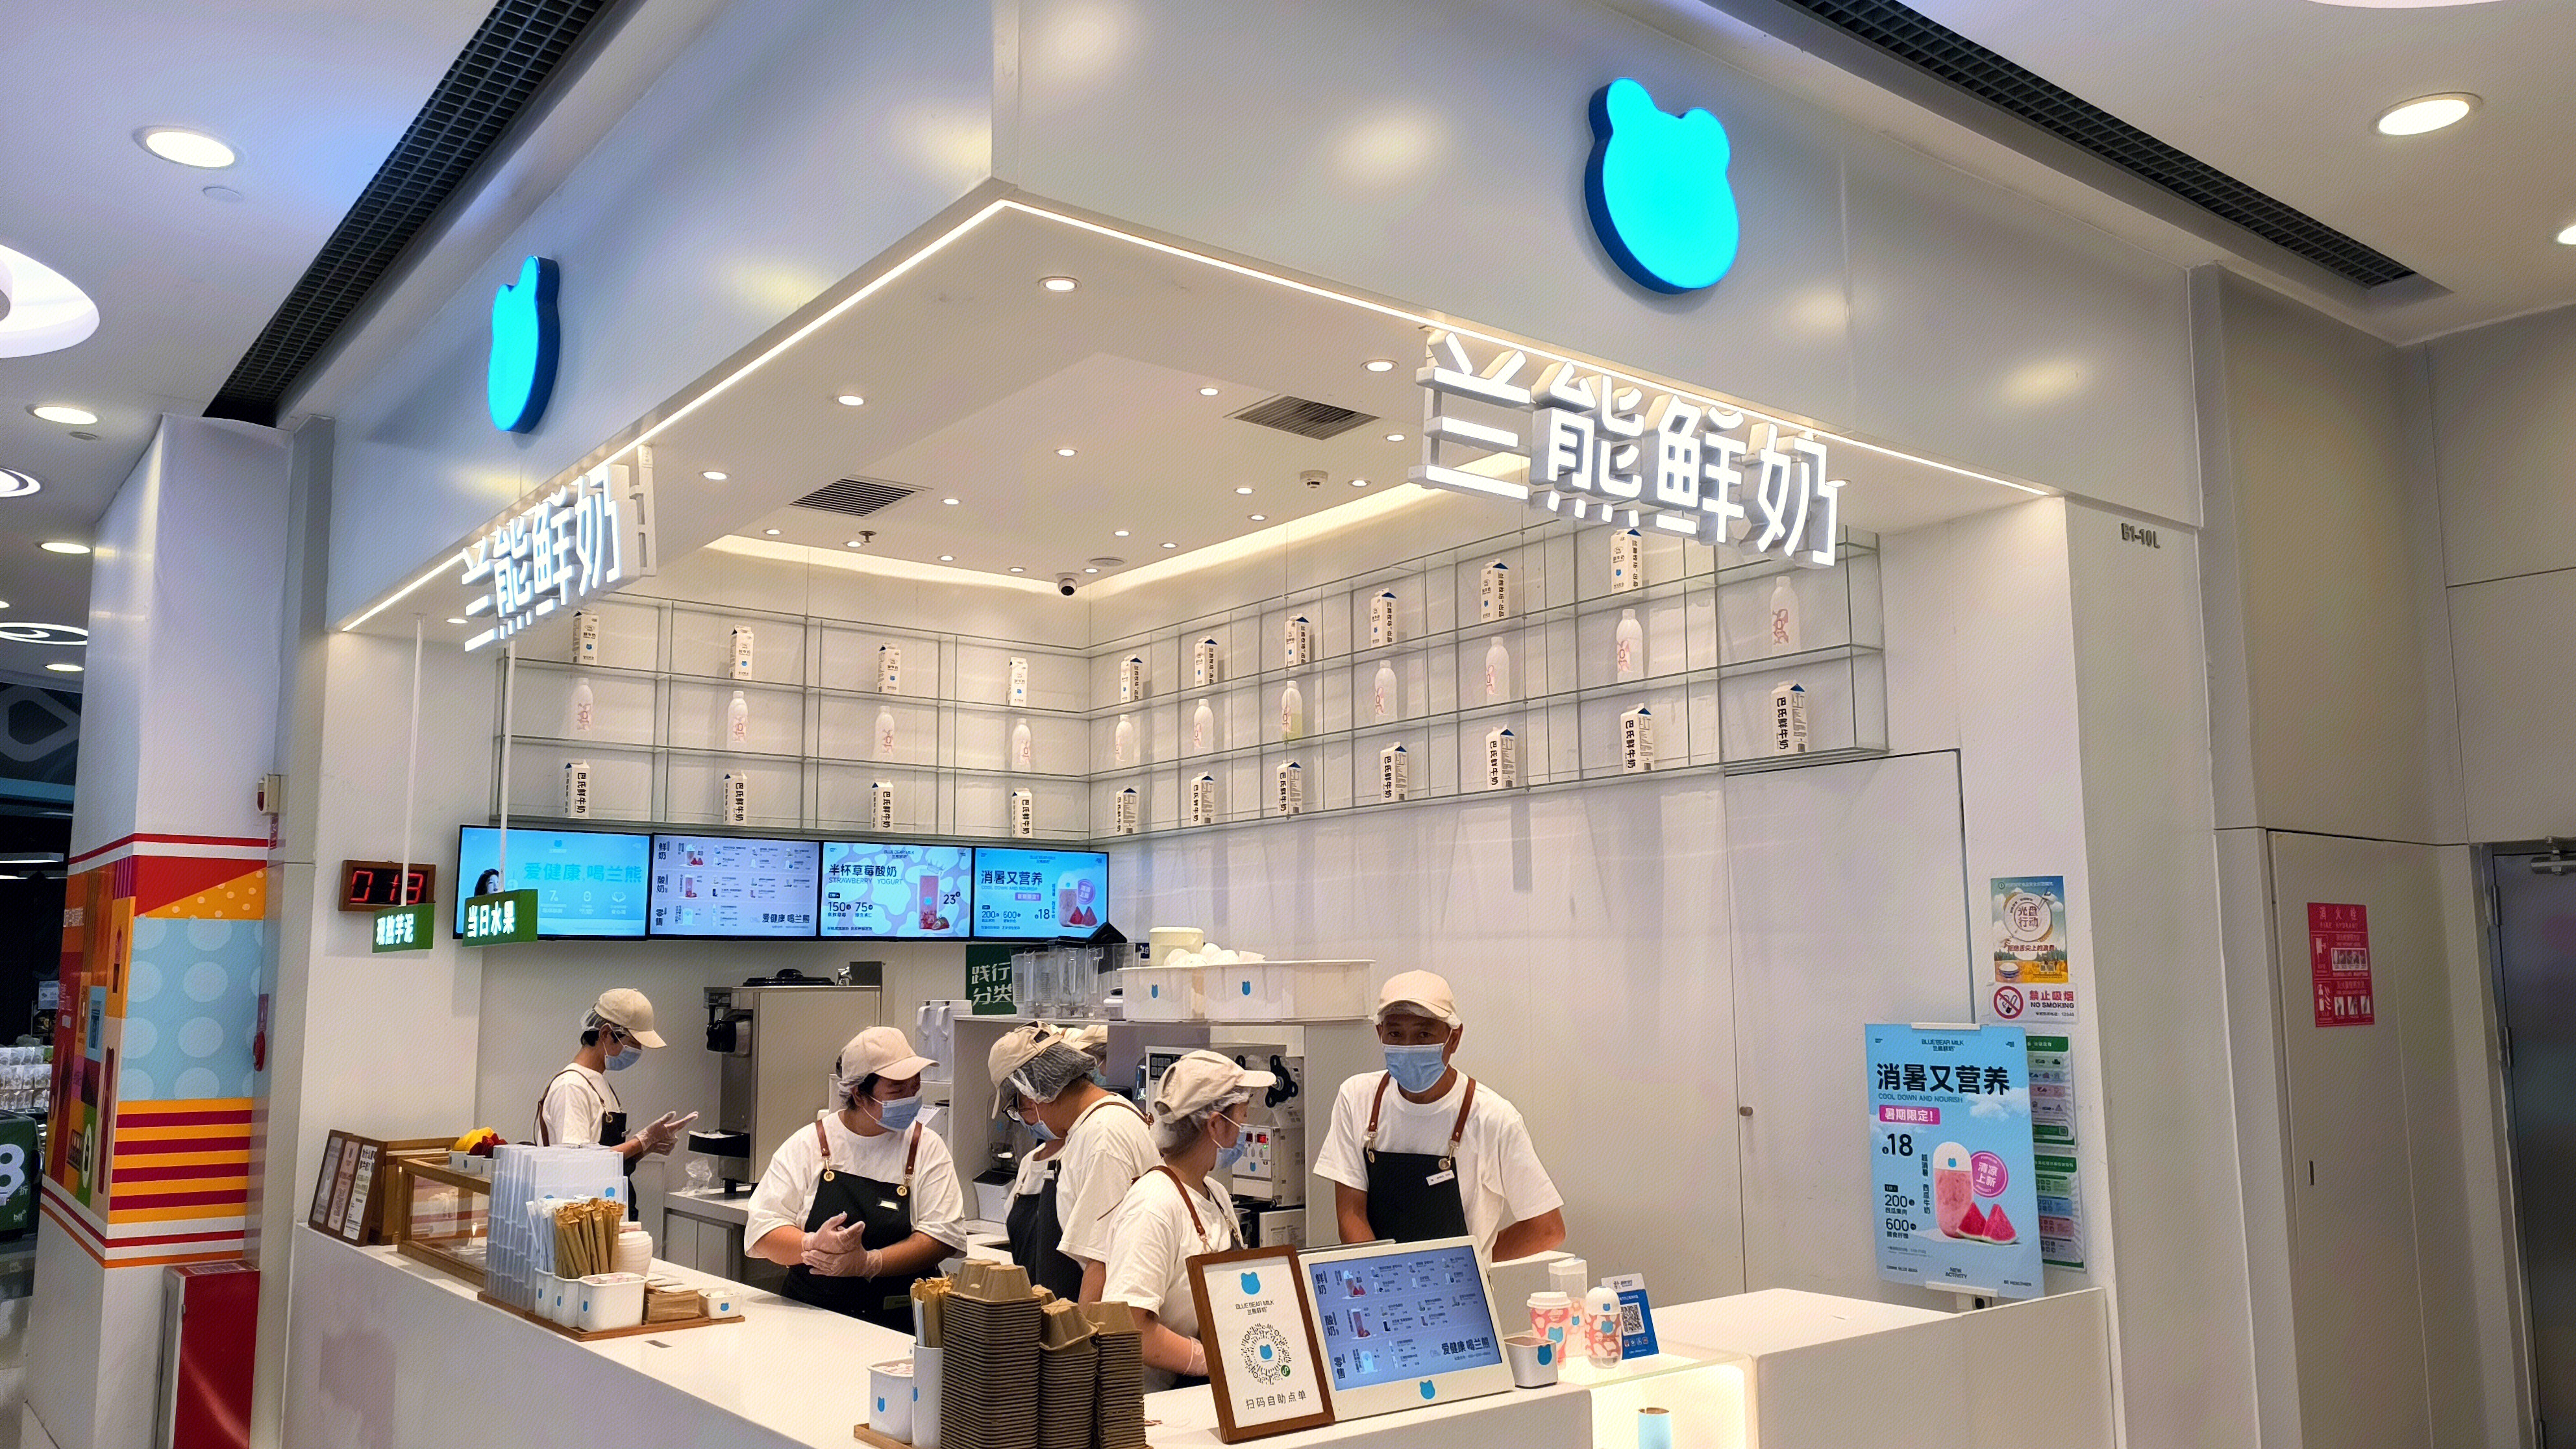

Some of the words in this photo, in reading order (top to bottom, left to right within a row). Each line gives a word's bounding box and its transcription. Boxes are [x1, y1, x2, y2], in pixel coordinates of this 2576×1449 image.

[1426, 332, 1837, 567] 兰熊鲜奶
[2121, 523, 2161, 549] B1-10L
[462, 465, 621, 651] 兰熊鲜奶
[1777, 697, 1789, 749] 巴氏鲜牛奶
[1626, 720, 1635, 768] 巴氏鲜牛奶
[576, 773, 586, 813] 巴氏鲜牛奶
[735, 782, 744, 821] 巴氏鲜牛奶
[882, 791, 891, 828] 巴氏鲜牛奶
[829, 864, 897, 877] 半杯草莓酸奶
[981, 870, 1043, 886] 消暑又营养
[828, 902, 845, 912] 150
[855, 902, 869, 912] 75
[2018, 906, 2038, 916] 光盘
[467, 900, 515, 938] 当日水果
[2018, 917, 2038, 927] 行动
[971, 962, 1010, 984] 践行
[972, 984, 1013, 1006] 分类
[2029, 990, 2074, 1001] 禁止吸烟
[1877, 1063, 2010, 1095] 消暑又营养
[1885, 1108, 1934, 1122] 暑期限定!
[1976, 1173, 1996, 1188] 上新
[1885, 1194, 1907, 1208] 200
[1885, 1218, 1909, 1232] 600
[1246, 1389, 1307, 1410] 扫码自助点单
